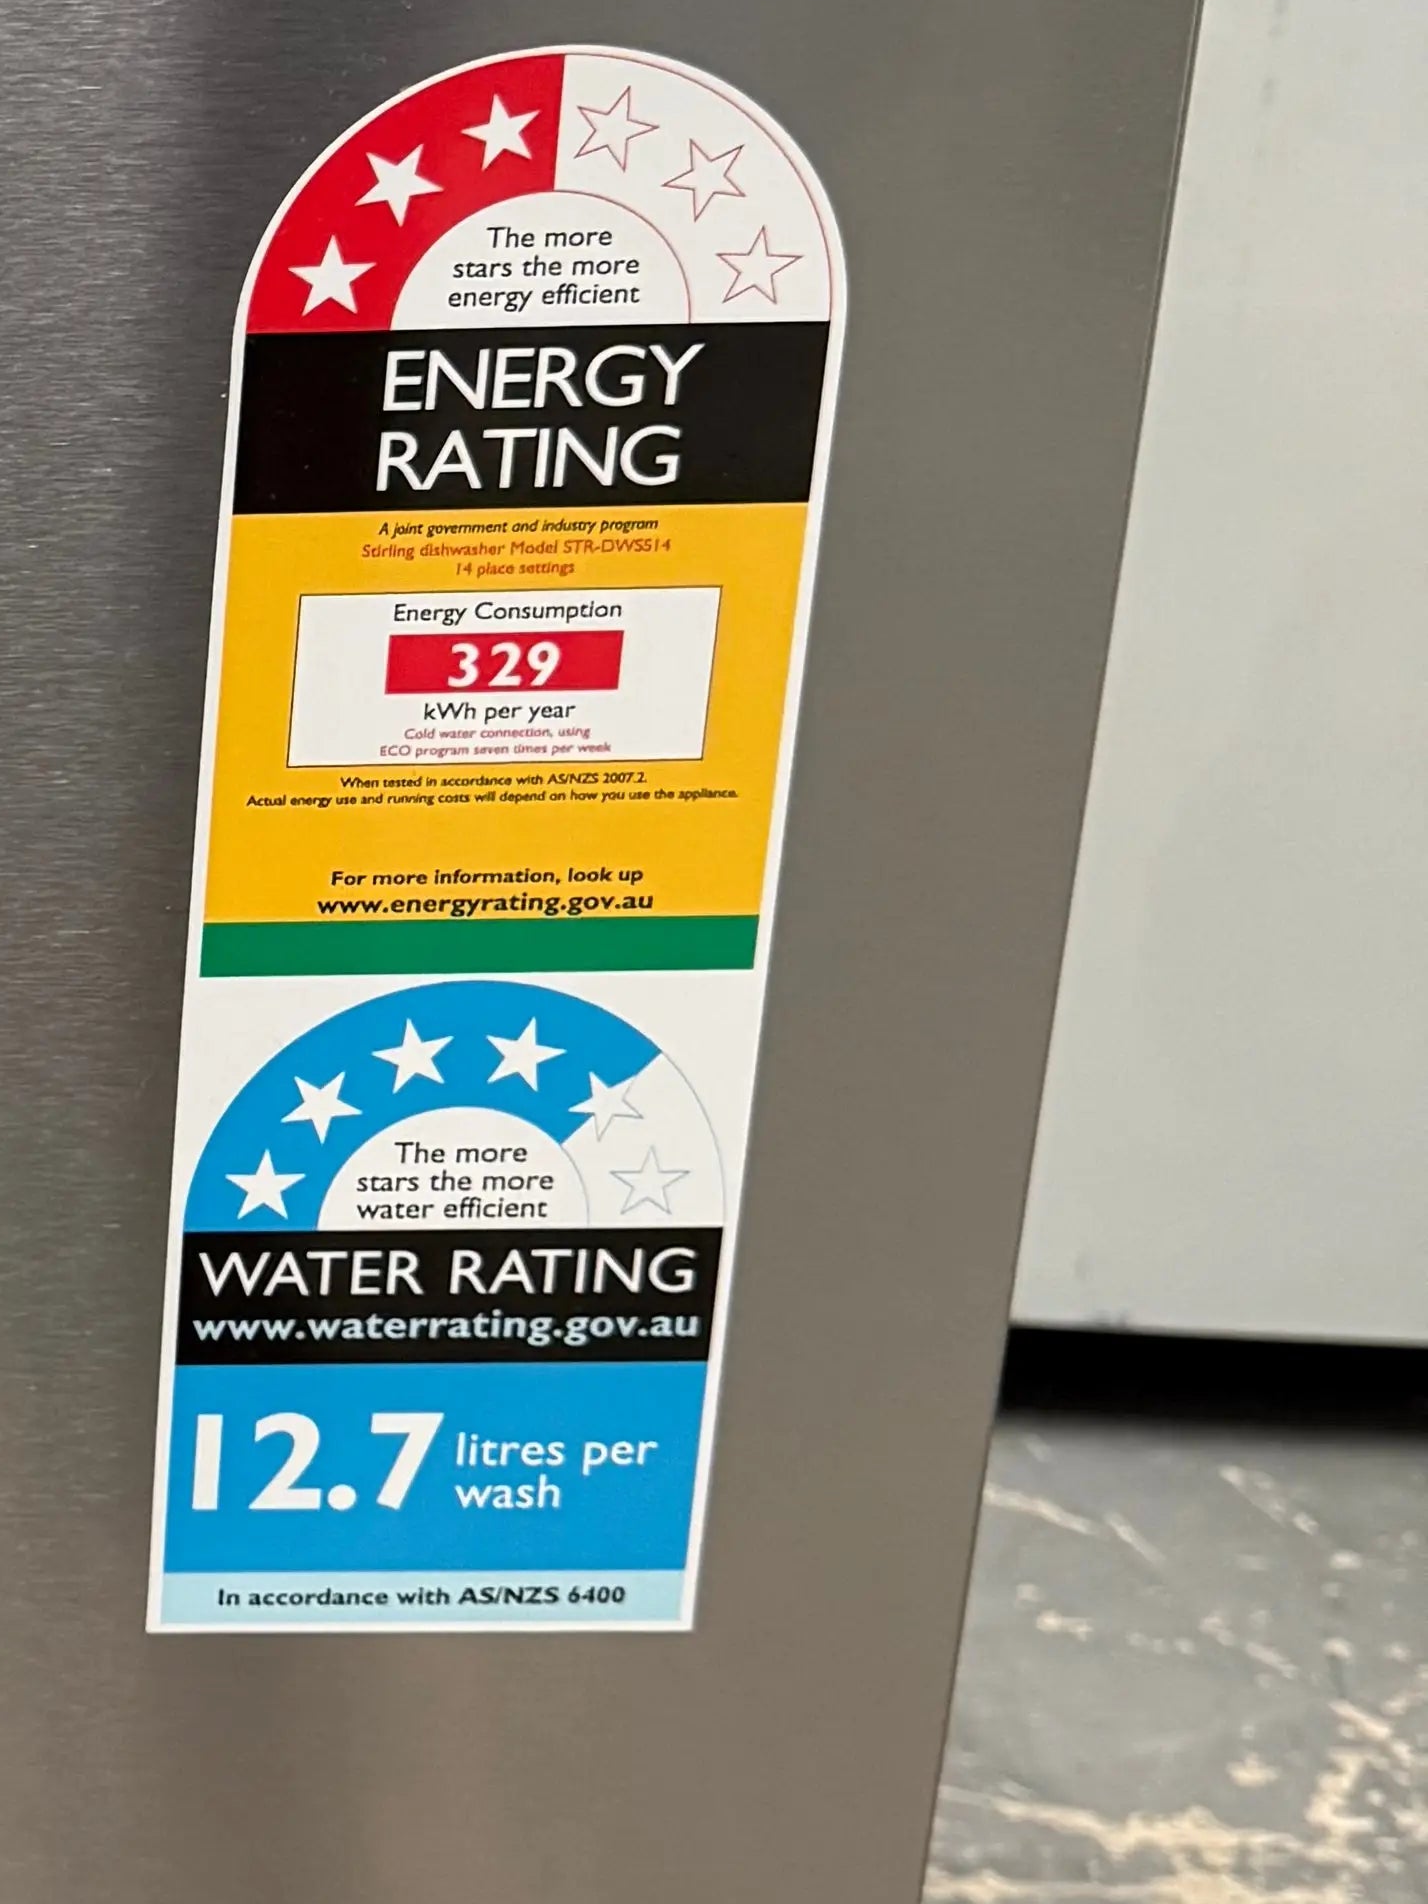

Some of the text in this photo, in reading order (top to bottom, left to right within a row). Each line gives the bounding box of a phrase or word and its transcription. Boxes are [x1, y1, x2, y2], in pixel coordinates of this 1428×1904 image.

[487, 226, 613, 249] The more
[453, 255, 640, 278] stars the more
[447, 284, 641, 312] energy efficient
[382, 343, 706, 412] ENERGY
[375, 426, 683, 492] RATING
[378, 518, 659, 538] A joint government and industry program
[361, 544, 414, 561] Stirling
[419, 543, 505, 556] dishwasher
[510, 541, 558, 555] Model
[456, 561, 574, 579] 14 place settings
[394, 601, 622, 625] Energy Consumption
[447, 641, 560, 688] 329
[423, 702, 576, 724] kWh per year
[404, 728, 436, 741] Cold
[439, 729, 476, 740] water
[558, 727, 591, 741] using
[380, 741, 611, 760] ECO program seven times per week
[340, 777, 379, 788] When
[383, 778, 422, 787] tested
[426, 777, 437, 786] in
[440, 775, 512, 787] accordance
[516, 775, 543, 785] with
[547, 774, 599, 785] AS/NZS
[246, 795, 286, 807] Actual
[290, 796, 332, 808] energy
[336, 796, 357, 805] use
[361, 793, 383, 804] and
[388, 793, 435, 805] running
[438, 793, 470, 803] costs
[475, 791, 496, 802] will
[499, 790, 545, 804] depend
[549, 792, 566, 801] on
[570, 790, 598, 800] how
[601, 790, 625, 803] you
[629, 790, 650, 799] use
[654, 789, 675, 799] the
[331, 868, 643, 886] For more information, look up
[317, 893, 654, 917] www.energyrating.gov.au
[394, 1142, 528, 1164] The more
[356, 1171, 554, 1193] stars the more
[357, 1197, 548, 1220] water efficient
[198, 1248, 697, 1296] WATER RATING
[193, 1309, 699, 1347] www.waterrating.gov.au
[191, 1412, 657, 1511] 12.7 litres per
[455, 1474, 561, 1510] wash
[218, 1586, 625, 1606] In accordance with AS/NZS 6400
